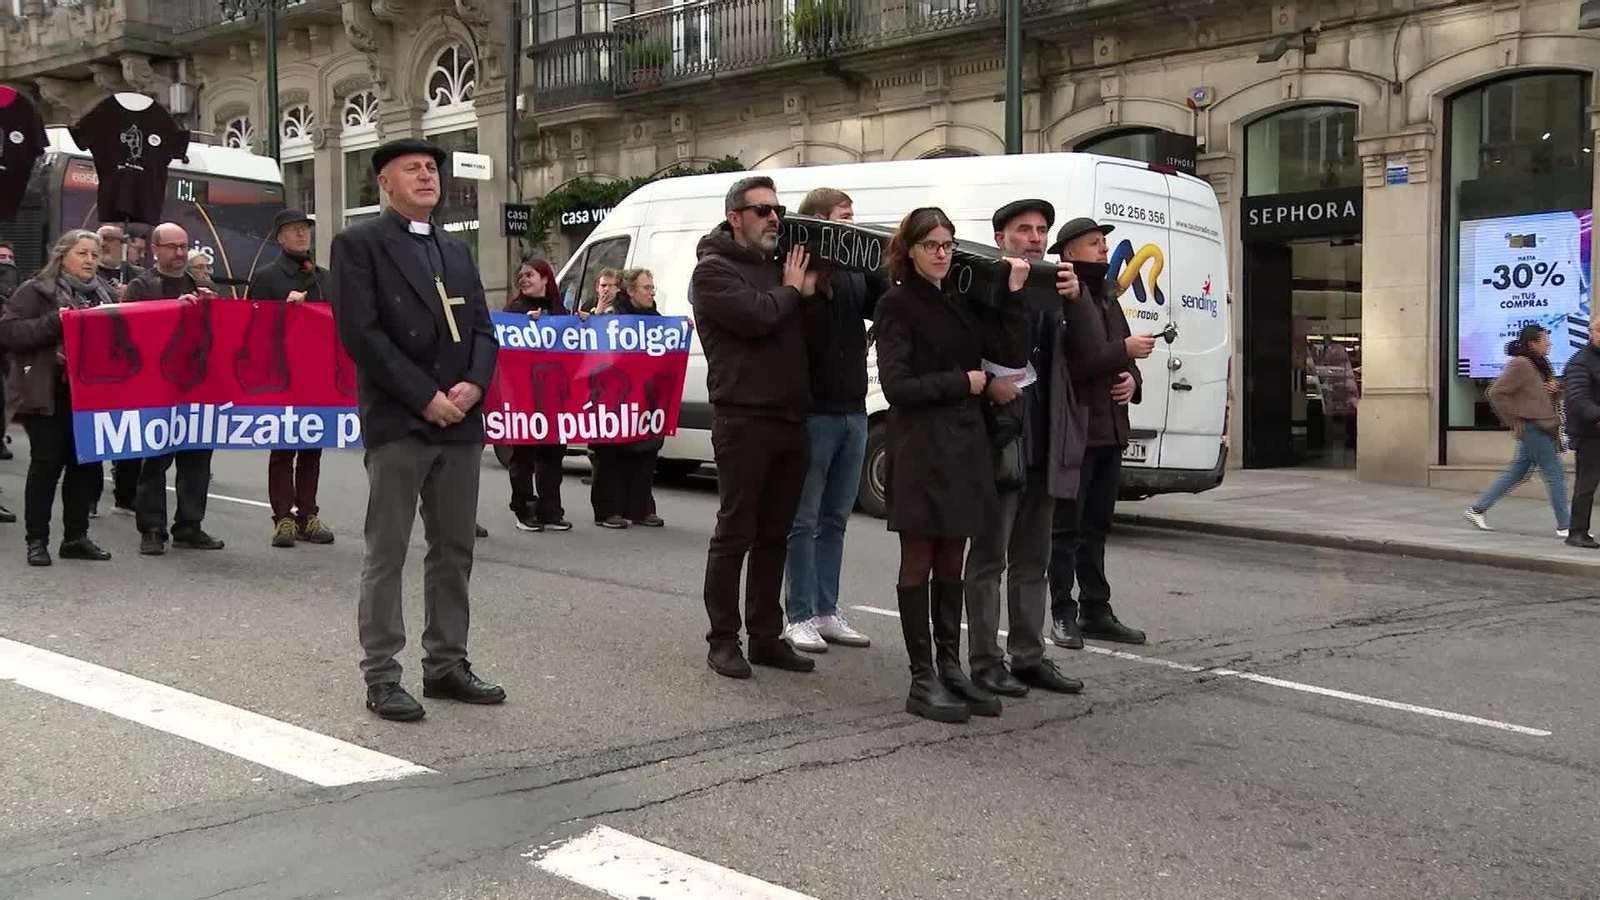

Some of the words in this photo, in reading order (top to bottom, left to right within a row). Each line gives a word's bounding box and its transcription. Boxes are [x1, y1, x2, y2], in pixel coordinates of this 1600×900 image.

[1166, 156, 1194, 168] SEPHORA
[507, 210, 529, 220] casa
[561, 209, 589, 226] casa
[591, 206, 614, 222] viv
[1104, 202, 1125, 217] 902
[1127, 205, 1146, 220] 256
[1148, 210, 1166, 225] 356
[1249, 200, 1356, 226] SEPHORA
[508, 220, 528, 231] viva
[820, 226, 882, 272] ENSINO
[1482, 261, 1566, 290] -30%
[1181, 292, 1218, 318] sending
[1500, 299, 1549, 309] COMPRAS
[1521, 292, 1536, 300] TUS
[493, 320, 557, 349] rado
[562, 327, 598, 350] en
[606, 319, 689, 357] folga!
[93, 401, 325, 456] Mobilízate
[337, 412, 362, 448] p
[481, 402, 549, 440] sino
[557, 400, 666, 445] público
